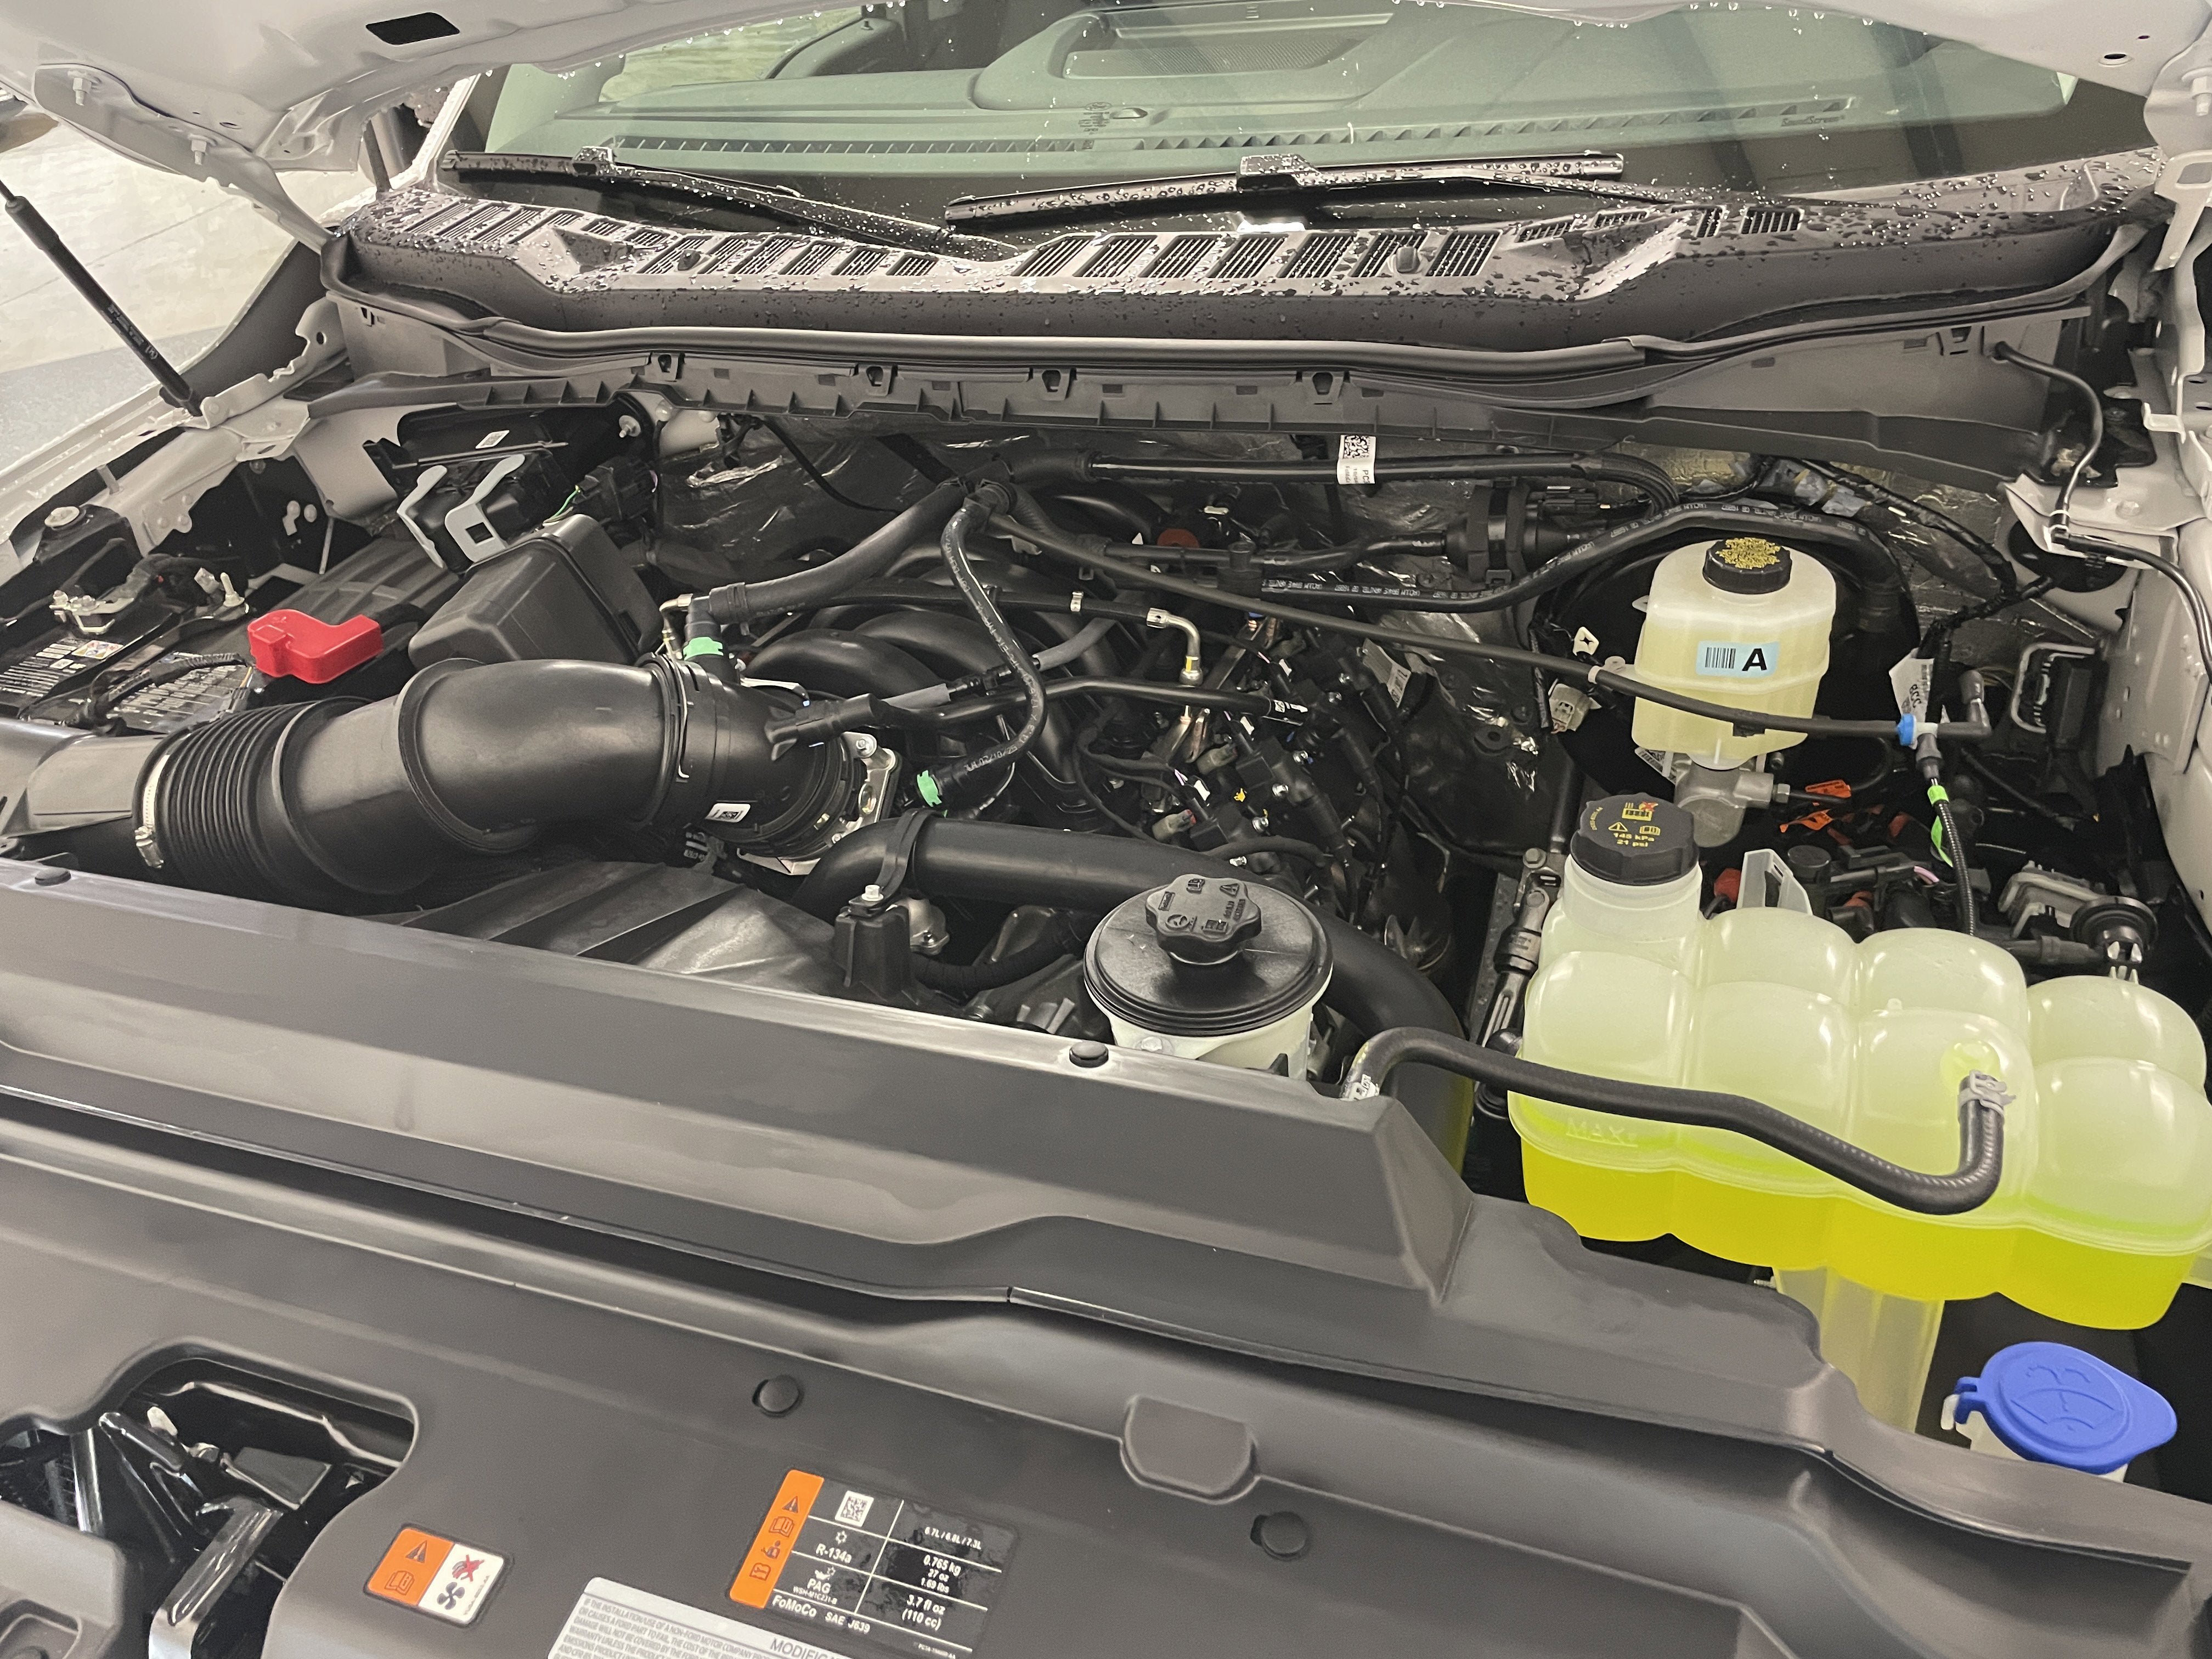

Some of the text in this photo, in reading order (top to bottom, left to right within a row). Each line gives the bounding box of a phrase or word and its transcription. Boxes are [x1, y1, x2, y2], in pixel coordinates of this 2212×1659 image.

[1742, 648, 1767, 671] A
[815, 1543, 852, 1564] R-134a
[923, 1554, 961, 1576] 0.765 kg
[928, 1568, 950, 1582] 27 oz
[807, 1578, 831, 1594] PAG
[937, 1582, 950, 1594] lbs
[772, 1594, 871, 1634] FoMoCo SAE J639
[906, 1594, 923, 1608] 3.7
[932, 1605, 946, 1615] oz
[902, 1608, 942, 1631] (110 cc)
